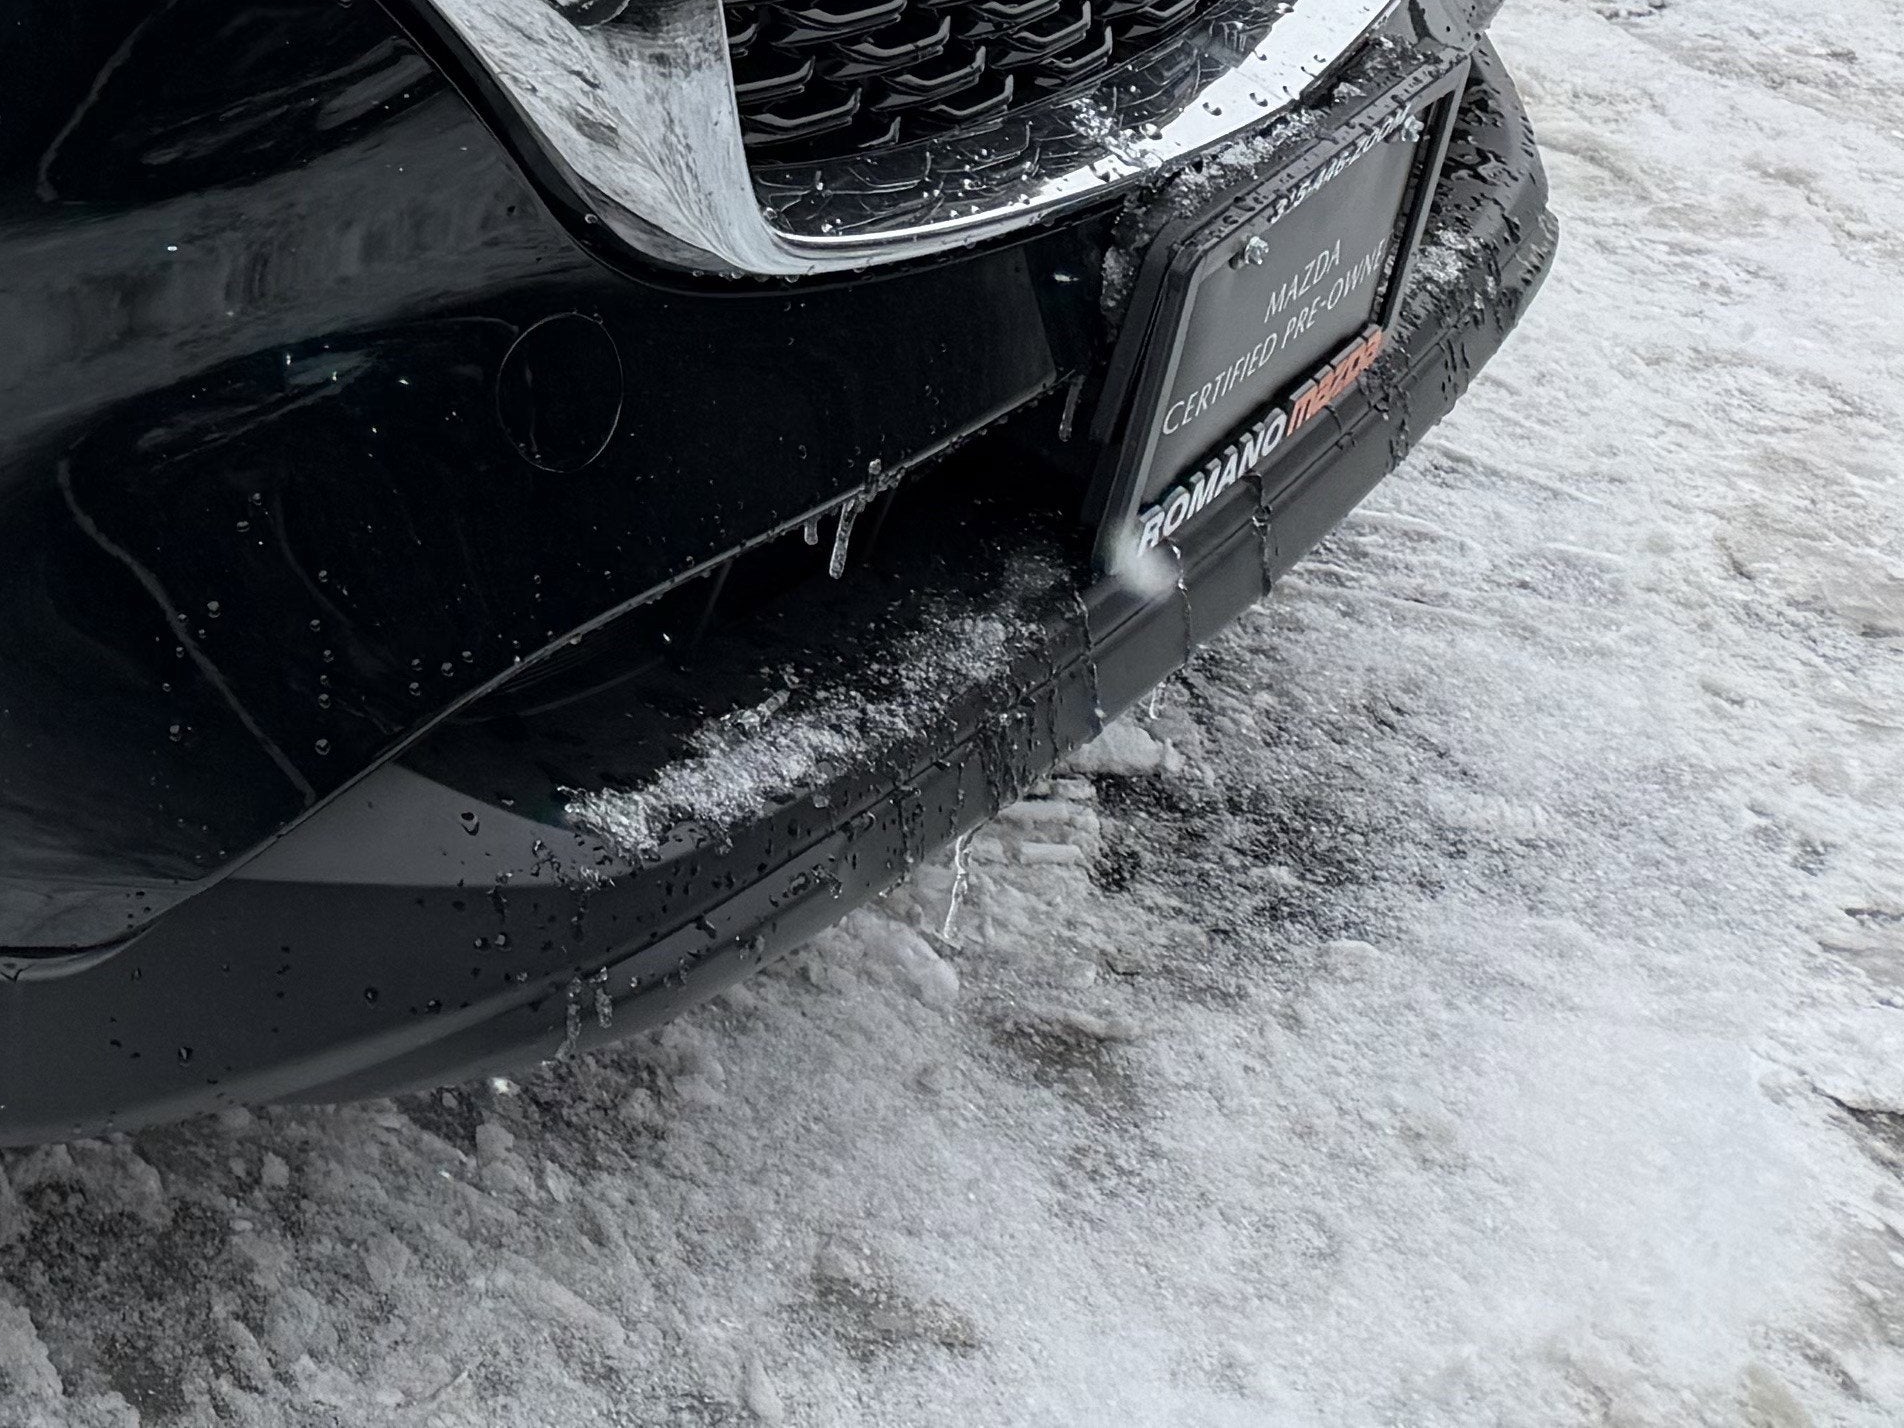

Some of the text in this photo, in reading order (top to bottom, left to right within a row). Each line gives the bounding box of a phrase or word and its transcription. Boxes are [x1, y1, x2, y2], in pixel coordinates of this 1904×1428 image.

[1162, 238, 1388, 435] CERTIFIED PRE-OWNE
[1264, 239, 1341, 323] MAZDA
[1137, 408, 1288, 557] ROMANO
